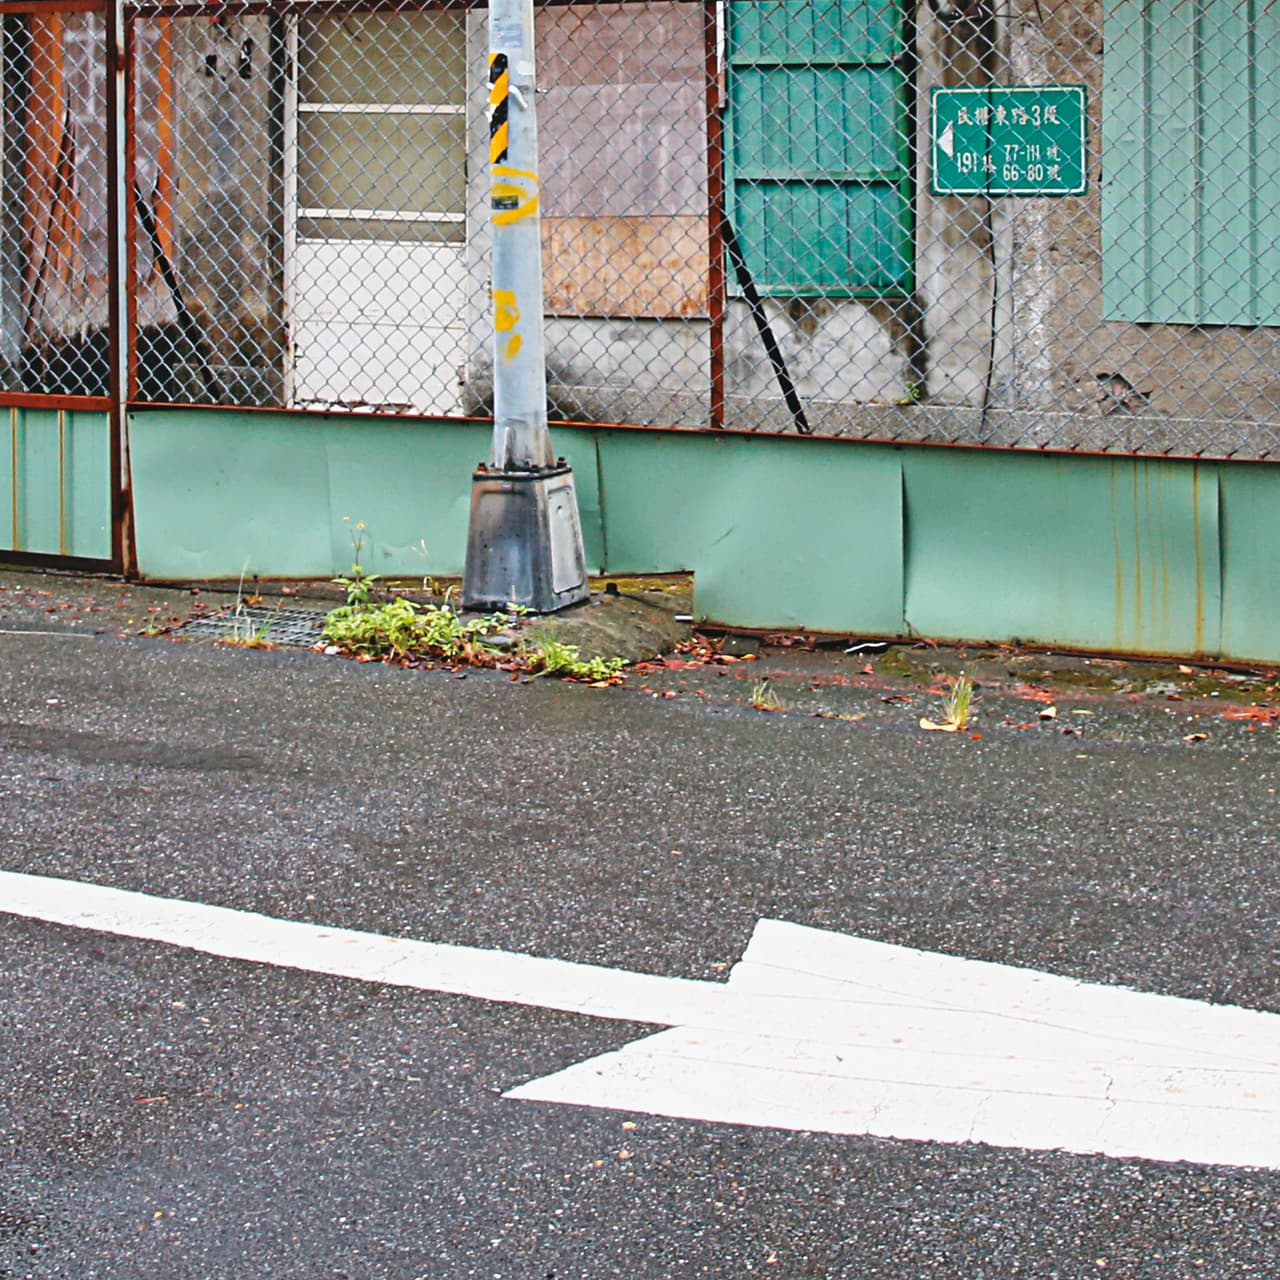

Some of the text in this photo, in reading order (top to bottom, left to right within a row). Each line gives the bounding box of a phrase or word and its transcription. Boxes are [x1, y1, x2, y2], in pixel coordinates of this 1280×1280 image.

[957, 104, 1061, 127] 民權東路3段
